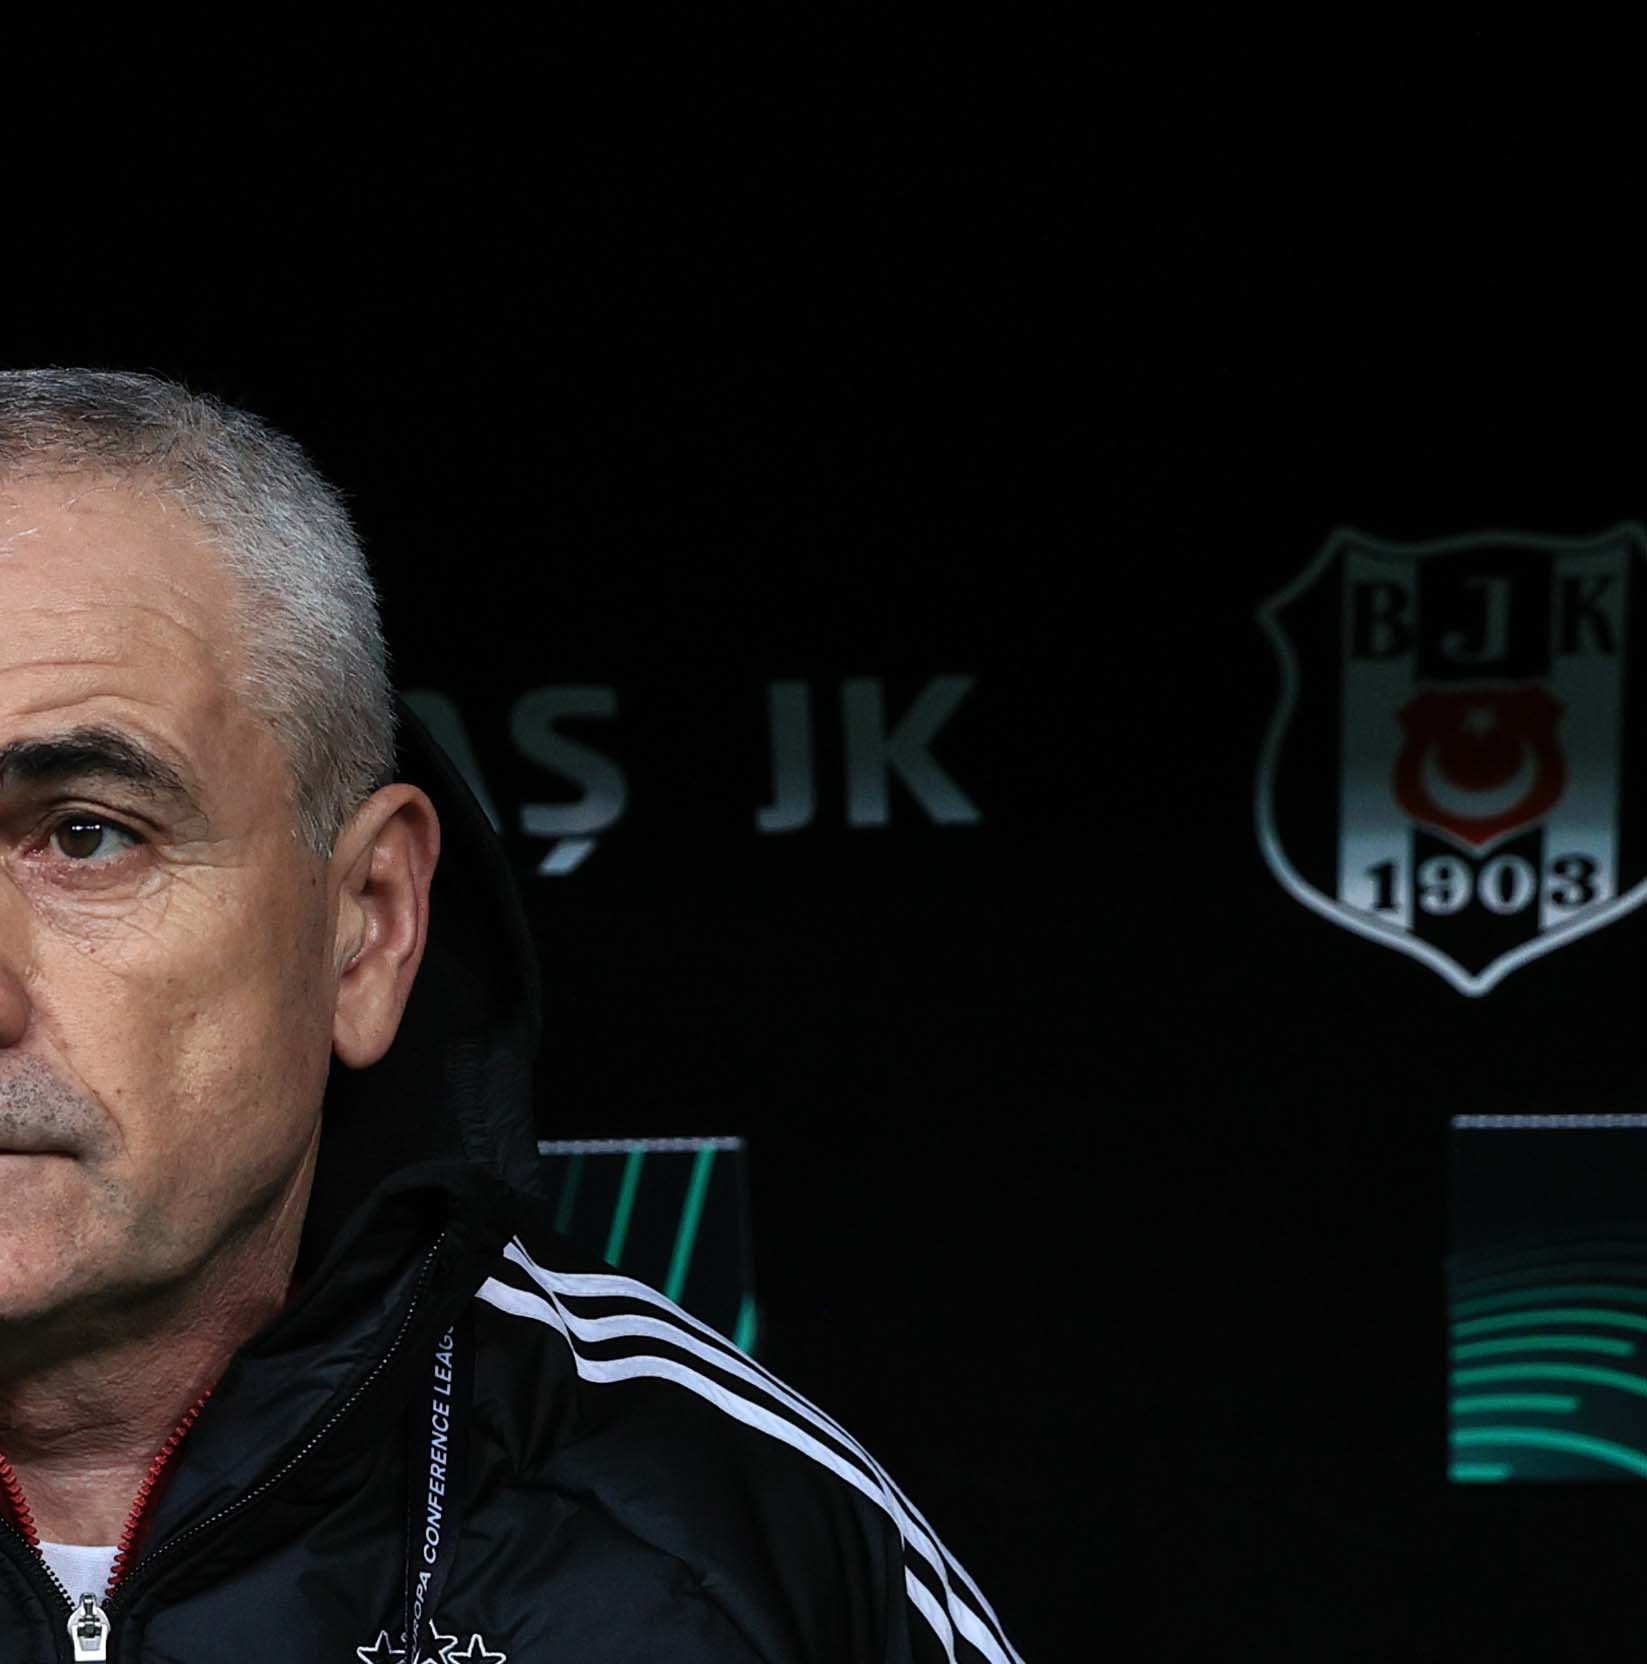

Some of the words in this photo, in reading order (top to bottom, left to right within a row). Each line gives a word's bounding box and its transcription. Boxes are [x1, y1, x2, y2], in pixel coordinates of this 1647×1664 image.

[1354, 575, 1615, 665] BJK
[754, 673, 986, 836] JK
[1368, 852, 1596, 917] 1903
[423, 1397, 451, 1566] CONFERENCE
